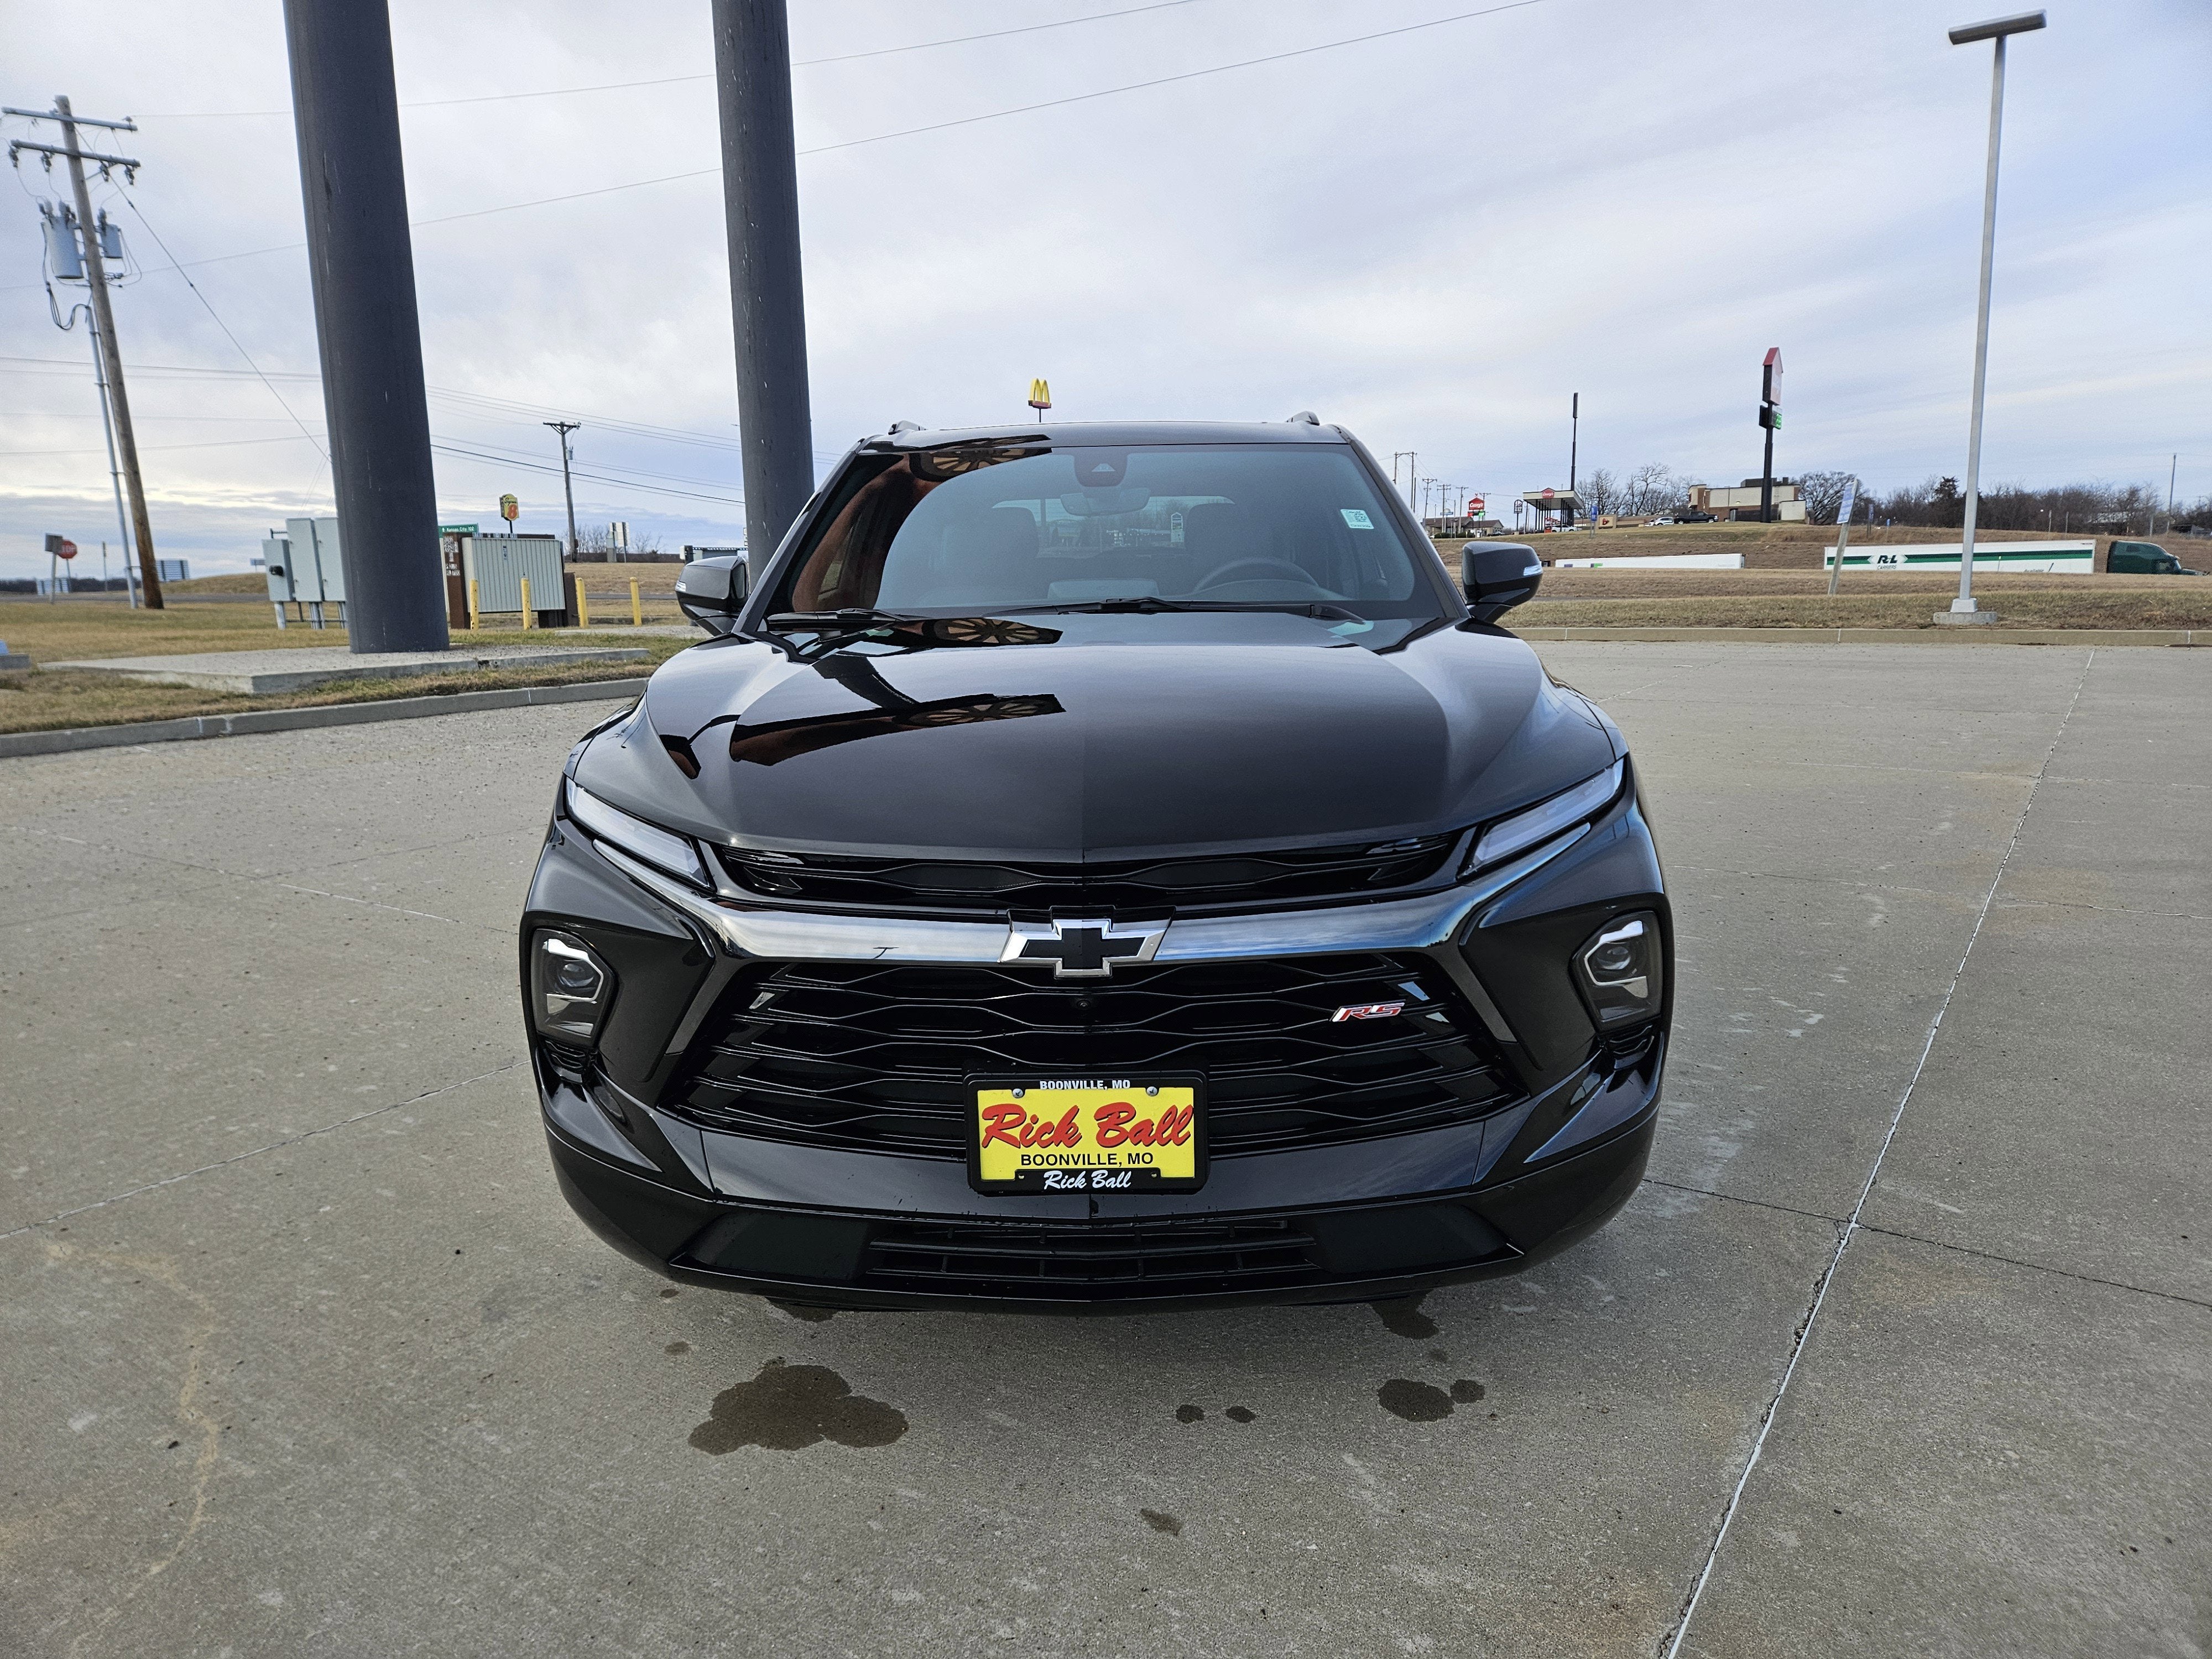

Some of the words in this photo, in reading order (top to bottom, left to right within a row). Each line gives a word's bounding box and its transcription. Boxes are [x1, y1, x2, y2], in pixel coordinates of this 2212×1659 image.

[507, 504, 518, 519] 8
[1332, 1002, 1405, 1022] RS
[1040, 1080, 1107, 1091] BOONVILLE,
[1112, 1079, 1130, 1089] MO
[981, 1103, 1082, 1149] Rick
[1093, 1102, 1194, 1148] Ball
[1020, 1153, 1122, 1167] BOONVILLE,
[1128, 1152, 1154, 1165] MO
[1044, 1170, 1087, 1190] Rick
[1091, 1170, 1131, 1189] Ball
